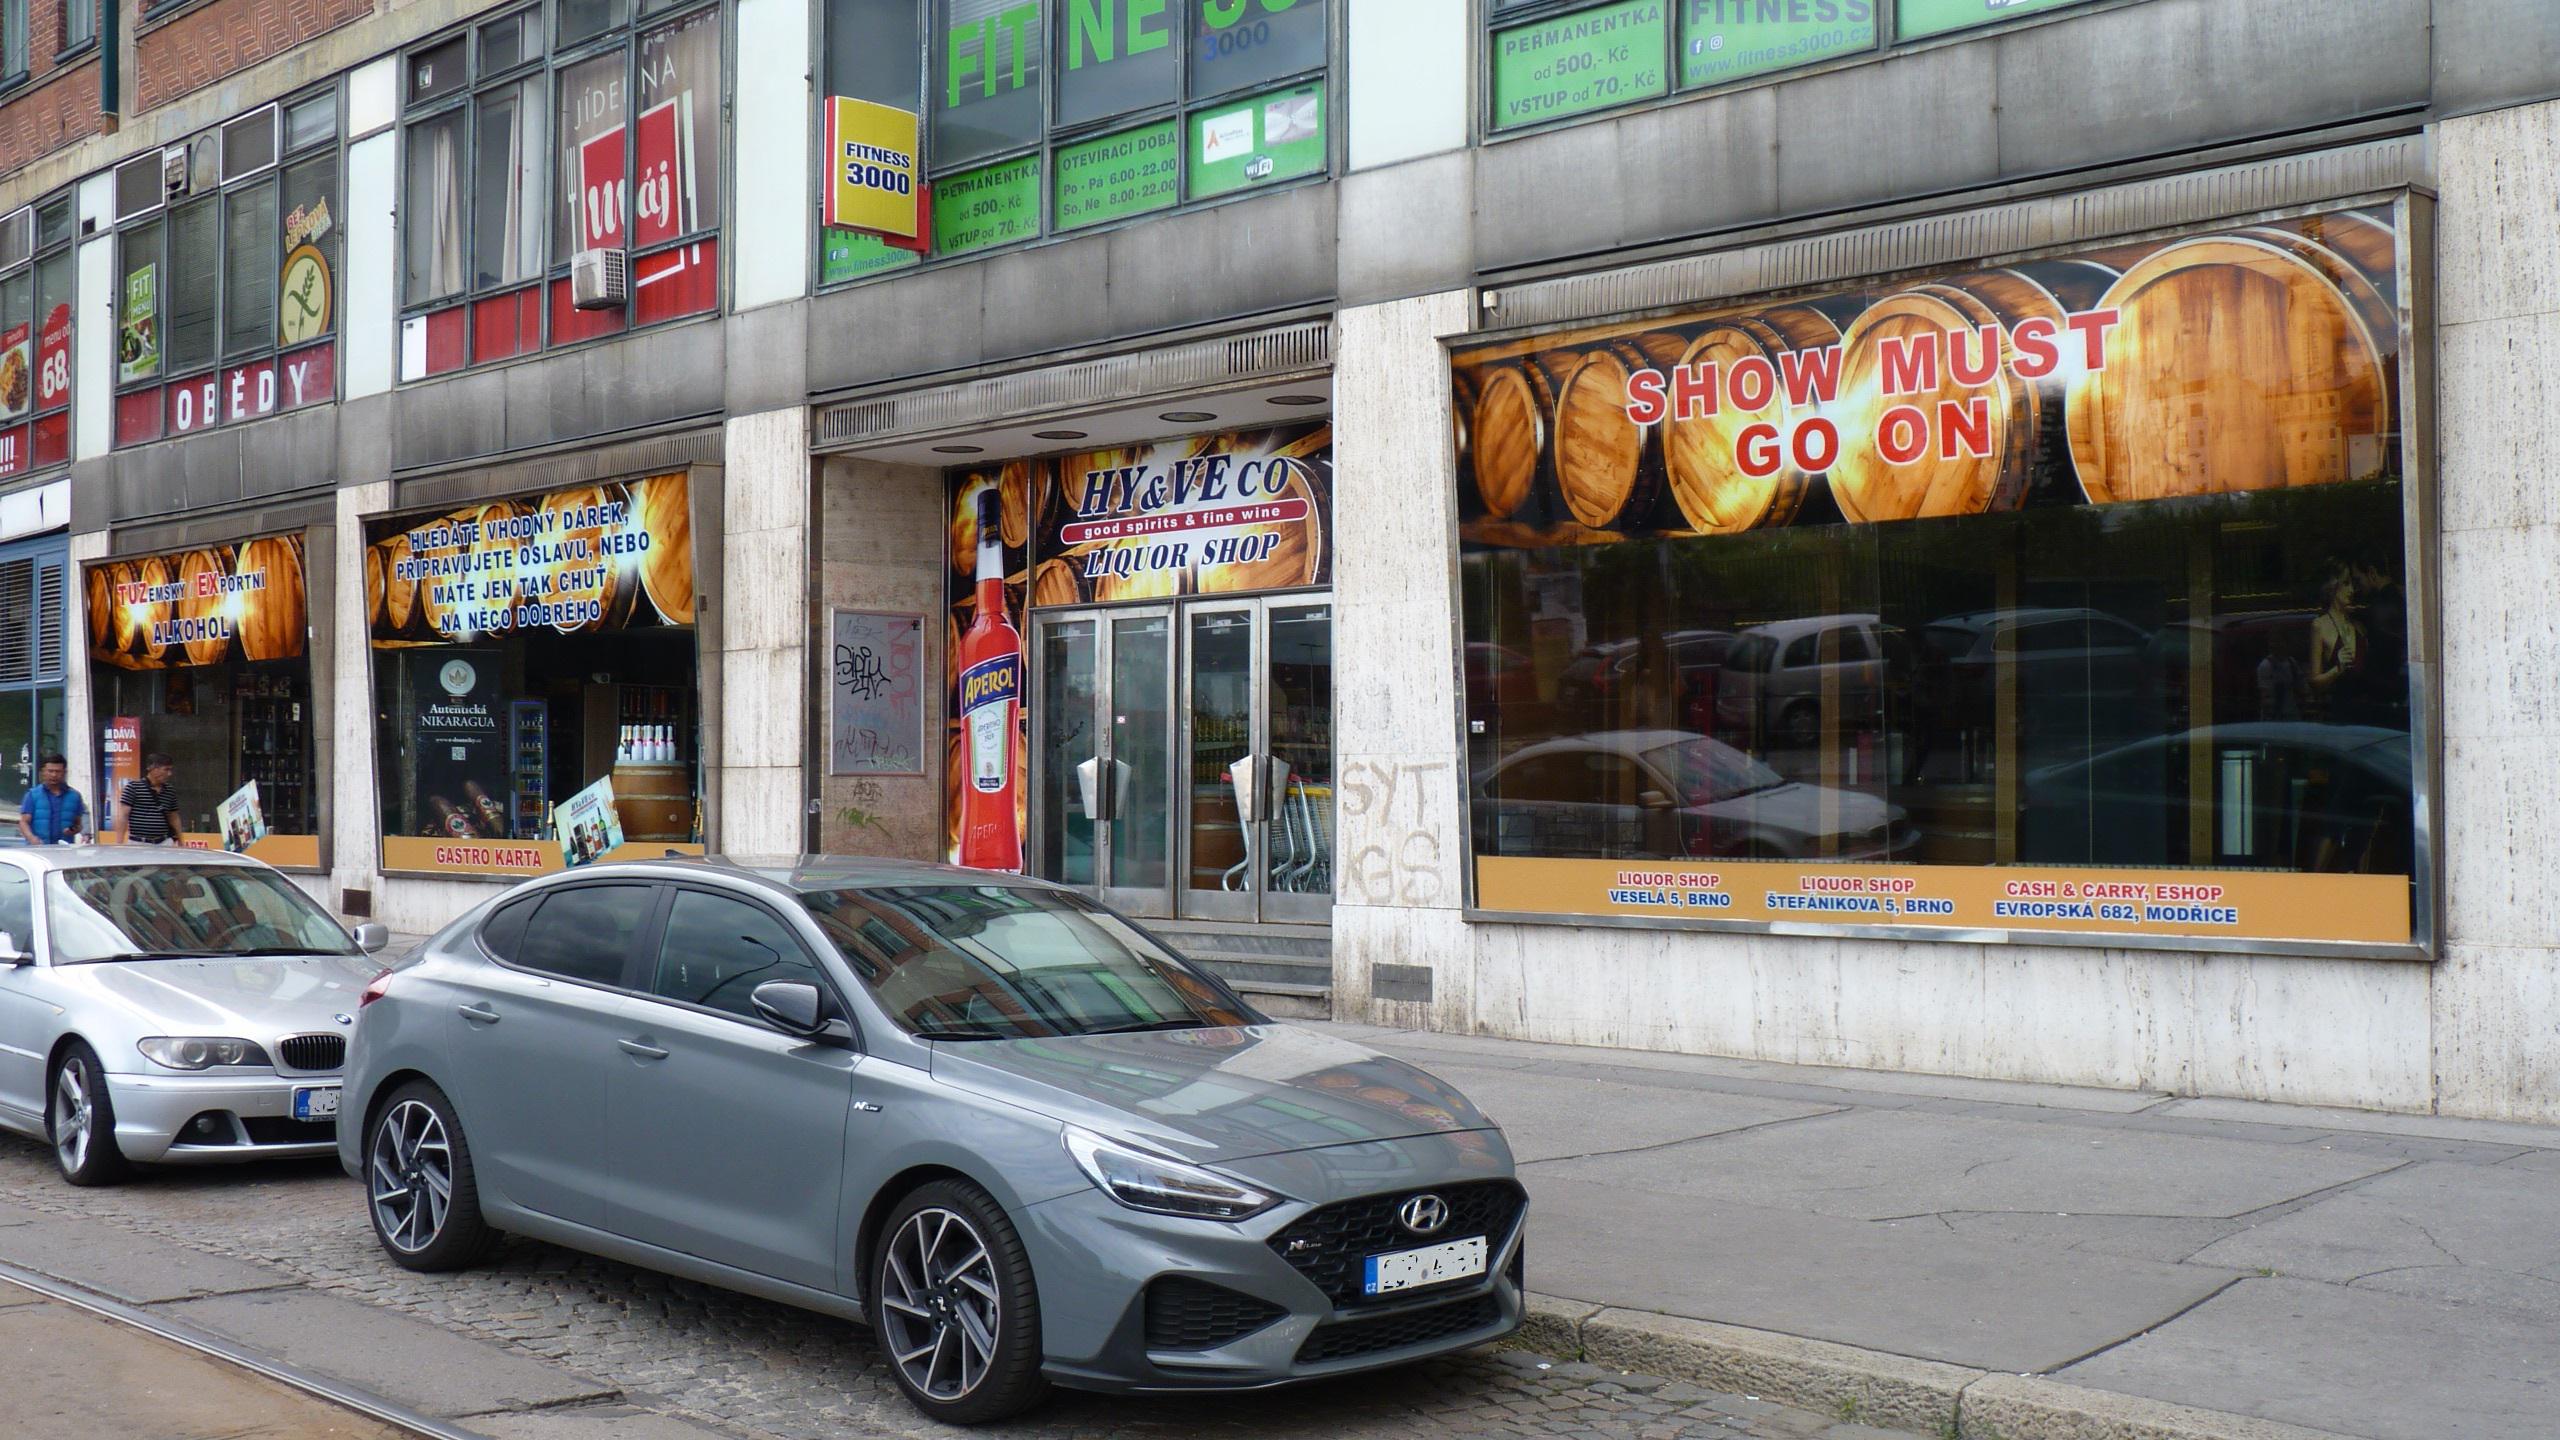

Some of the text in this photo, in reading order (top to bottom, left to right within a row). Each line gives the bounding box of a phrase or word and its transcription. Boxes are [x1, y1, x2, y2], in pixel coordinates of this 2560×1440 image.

[1691, 0, 1871, 25] FITNESS
[1203, 21, 1268, 61] 3000
[1506, 6, 1659, 56] PERMANENTKA
[1534, 64, 1551, 81] od
[1608, 45, 1629, 63] Kč
[1688, 26, 1872, 78] www.fitness3000.cz
[1510, 90, 1568, 115] VSTUP
[1572, 87, 1589, 103] od
[1634, 69, 1656, 88] Kč
[846, 142, 910, 169] FITNESS
[1138, 131, 1176, 152] DOBA
[847, 162, 910, 196] 3000
[941, 163, 1040, 200] PERMANENTKA
[1064, 184, 1078, 196] Po
[1085, 198, 1100, 211] Ne
[948, 229, 980, 249] VSTUP
[133, 274, 150, 300] FIT
[1626, 308, 2119, 425] SHOW MUST
[177, 361, 308, 430] OBĚDY
[1735, 398, 1992, 478] GO ON
[411, 520, 480, 552] HLEDÁTE
[487, 508, 555, 542] VHODNÝ
[1084, 506, 1281, 540] good spirits & fine wine
[397, 551, 513, 581] PŘIPRAVUJETE
[600, 530, 651, 556] NEBO
[1085, 533, 1281, 579] LIQUOR SHOP
[434, 580, 475, 605] MÁTE
[482, 578, 513, 600] JEN
[519, 574, 552, 597] TAK
[153, 616, 230, 645] ALKOHOL
[441, 599, 603, 634] NA NĚCO DOBRÉHO
[965, 666, 1015, 708] APEROL
[421, 715, 496, 728] NIKARAGUA
[429, 703, 487, 715] Autentická
[436, 845, 542, 868] GASTRO KARTA
[1619, 872, 1720, 888] LIQUOR SHOP
[1802, 877, 1915, 893] LIQUOR SHOP
[2006, 882, 2223, 901] CASH & CARRY, ESHOP
[1609, 886, 1731, 908] VESELÁ 5, BRNO
[1767, 892, 1954, 915] ŠTEFÁNIKOVA 5, BRNO
[1996, 901, 2237, 923] EVROPSKÁ 682, MODŘICE
[1366, 1282, 1377, 1293] CZ
